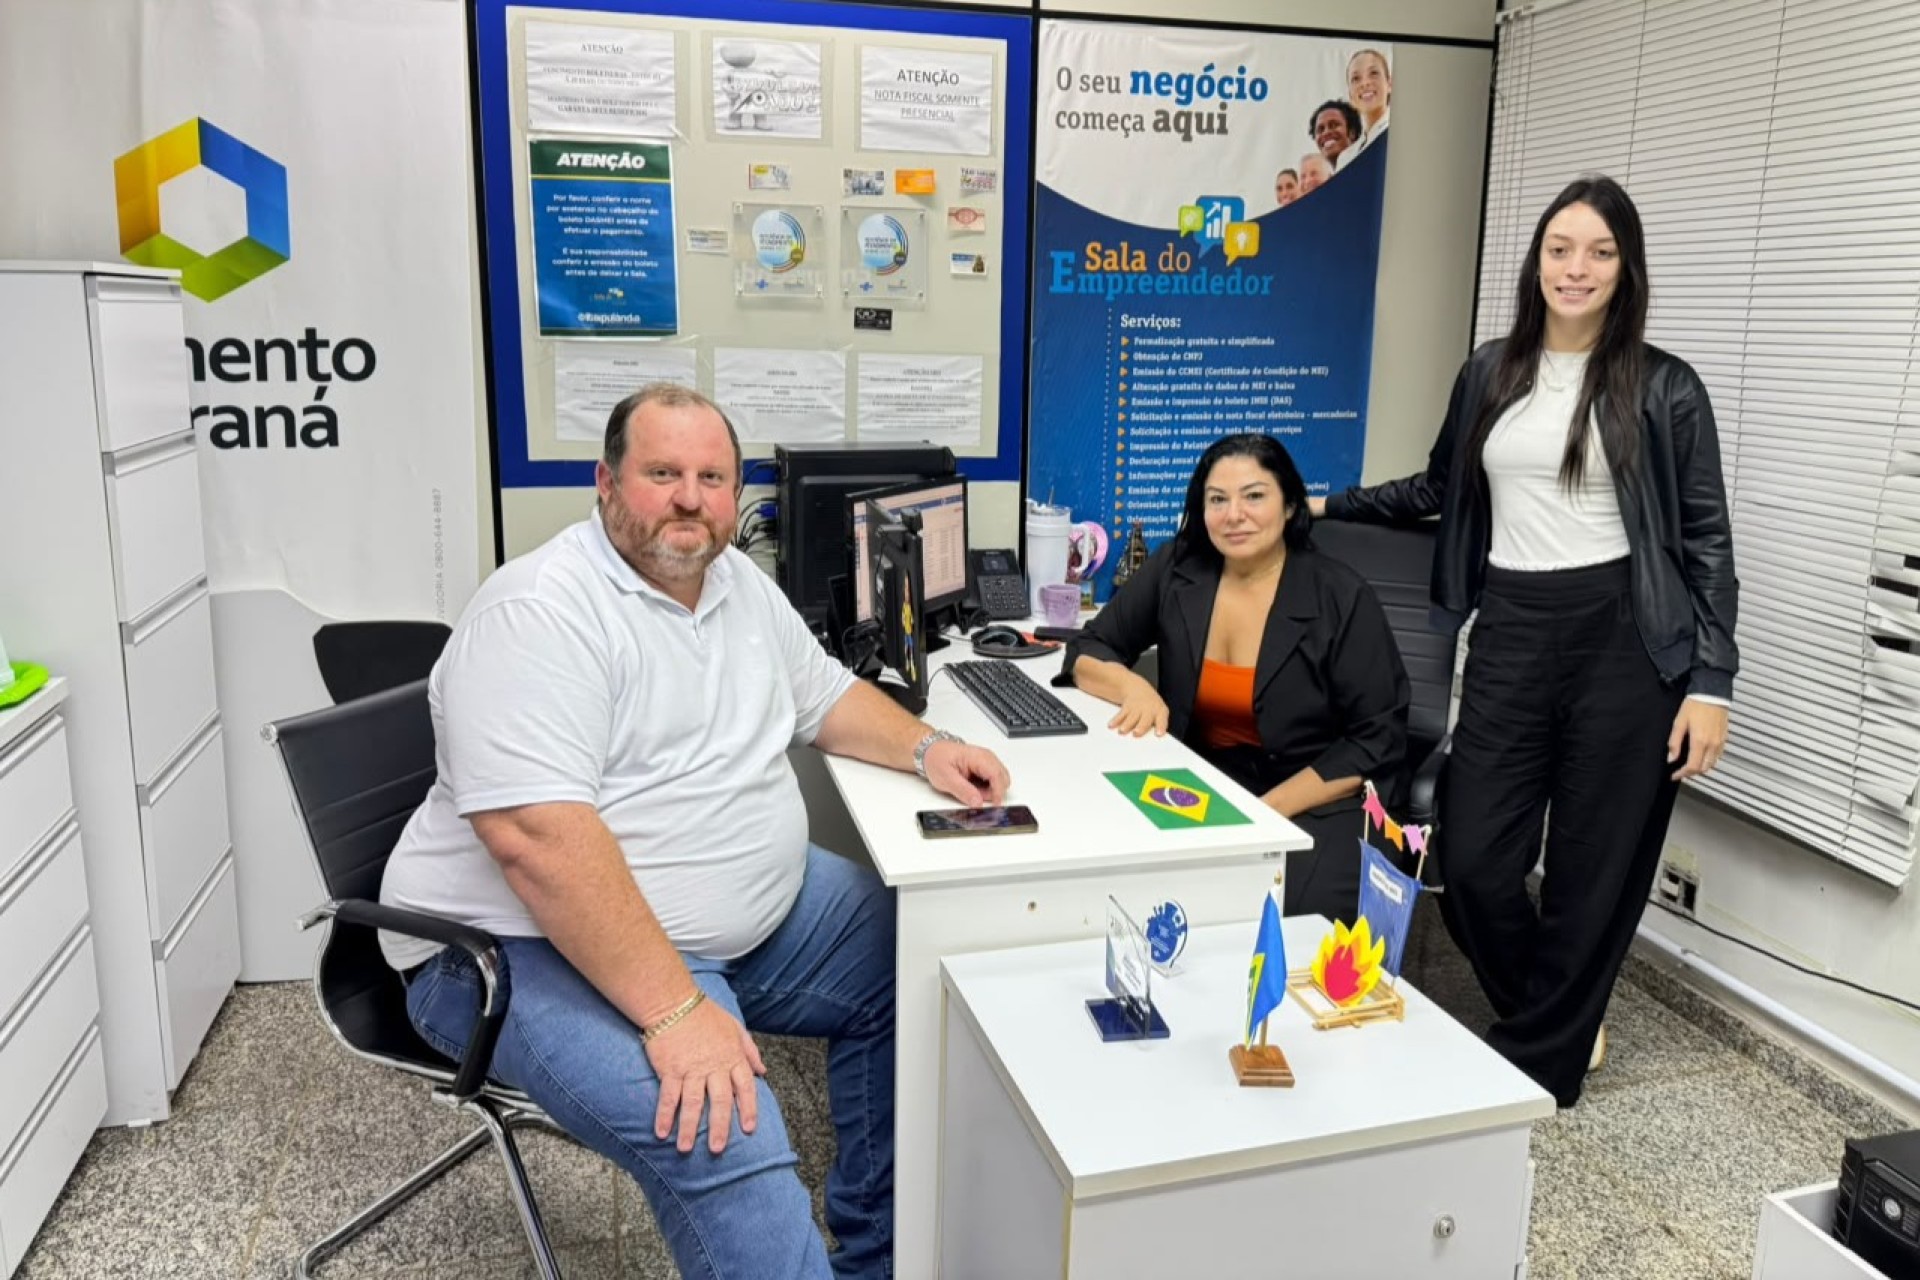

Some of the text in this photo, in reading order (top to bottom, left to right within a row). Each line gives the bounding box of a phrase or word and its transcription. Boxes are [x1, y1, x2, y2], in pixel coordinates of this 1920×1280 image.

[581, 43, 624, 54] ATENÇÃO
[897, 68, 960, 86] ATENÇÃO
[1057, 63, 1268, 105] O seu negócio
[874, 89, 979, 105] NOTA FISCAL SOMENTE
[901, 107, 954, 121] PRESENCIAL
[1055, 102, 1228, 142] começa aqui
[557, 151, 645, 171] ATENÇÃO
[1085, 242, 1191, 272] Sala do
[1050, 251, 1273, 301] Empreendedor
[1121, 314, 1181, 331] Serviços:
[1134, 336, 1185, 346] Formalização
[1187, 336, 1218, 347] gratuita
[1228, 336, 1274, 347] simplificada
[185, 327, 376, 383] ento
[1133, 351, 1169, 361] Obtenção
[1183, 352, 1203, 361] CNPJ
[1133, 366, 1165, 376] Emissão
[1205, 366, 1250, 378] (Certificado
[1263, 366, 1297, 377] Condição
[1132, 382, 1169, 392] Alteração
[1171, 382, 1202, 392] gratuita
[1216, 381, 1238, 390] dados
[1132, 397, 1163, 406] Emissão
[1172, 395, 1212, 407] impressão
[191, 386, 339, 449] raná
[1131, 411, 1172, 422] Solicitação
[1181, 411, 1212, 420] emissão
[1225, 411, 1243, 420] nota
[1245, 411, 1265, 420] fiscal
[1267, 410, 1304, 420] eletrônica
[1312, 408, 1357, 419] mercadorias
[1130, 425, 1171, 437] Solicitação
[1181, 425, 1212, 435] emissão
[1225, 425, 1242, 434] nota
[1244, 424, 1264, 434] fiscal
[1272, 425, 1301, 435] serviços
[1129, 441, 1169, 452] Impressão
[1129, 456, 1170, 466] Declaração
[1172, 456, 1194, 464] anual
[1128, 470, 1194, 481] Informações par
[1128, 485, 1159, 495] Emissão
[1127, 500, 1168, 510] Orientação
[434, 572, 445, 619] VIDORIA
